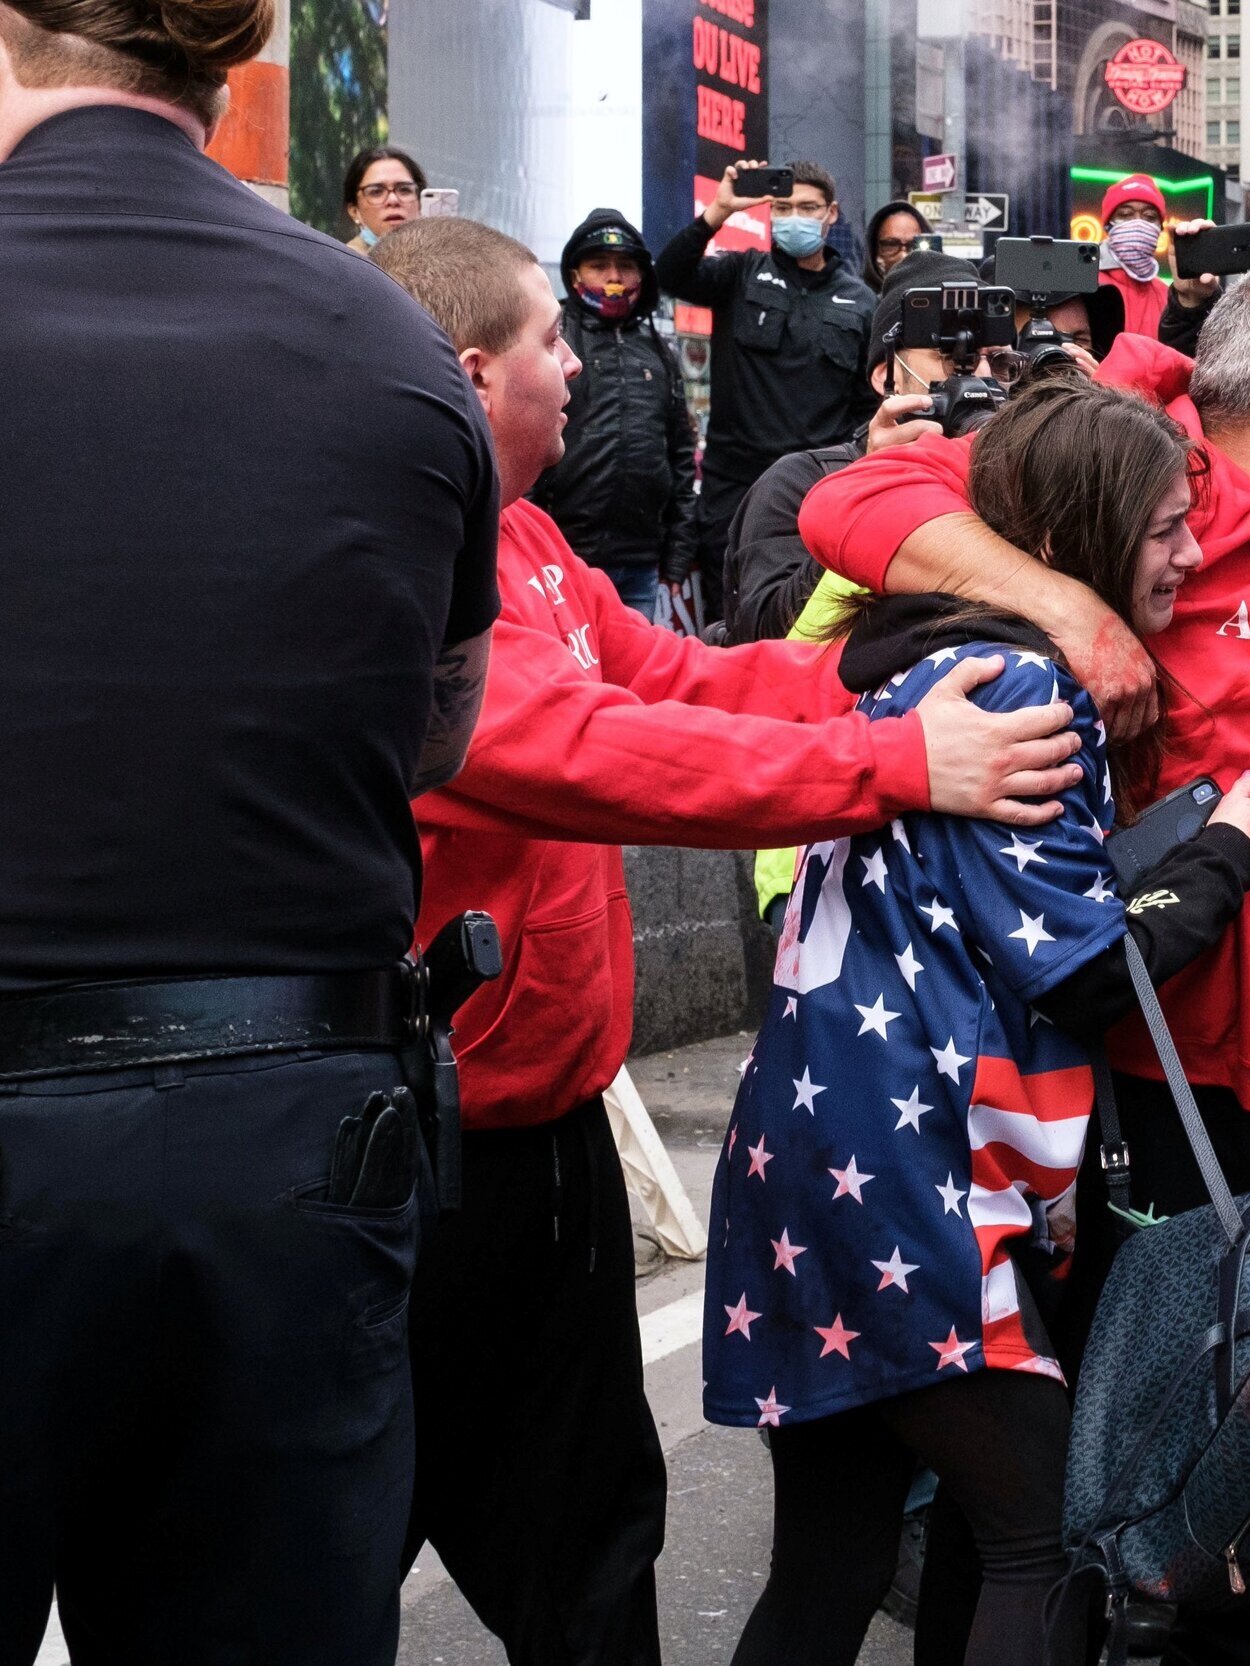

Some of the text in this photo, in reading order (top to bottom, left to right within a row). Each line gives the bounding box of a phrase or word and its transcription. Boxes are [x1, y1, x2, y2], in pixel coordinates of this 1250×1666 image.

[692, 15, 760, 95] OU LIVE
[1127, 45, 1163, 62] HOT
[1126, 89, 1163, 107] NOW
[697, 84, 746, 152] HERE
[923, 204, 991, 217] ON WAY
[963, 391, 988, 399] Canon
